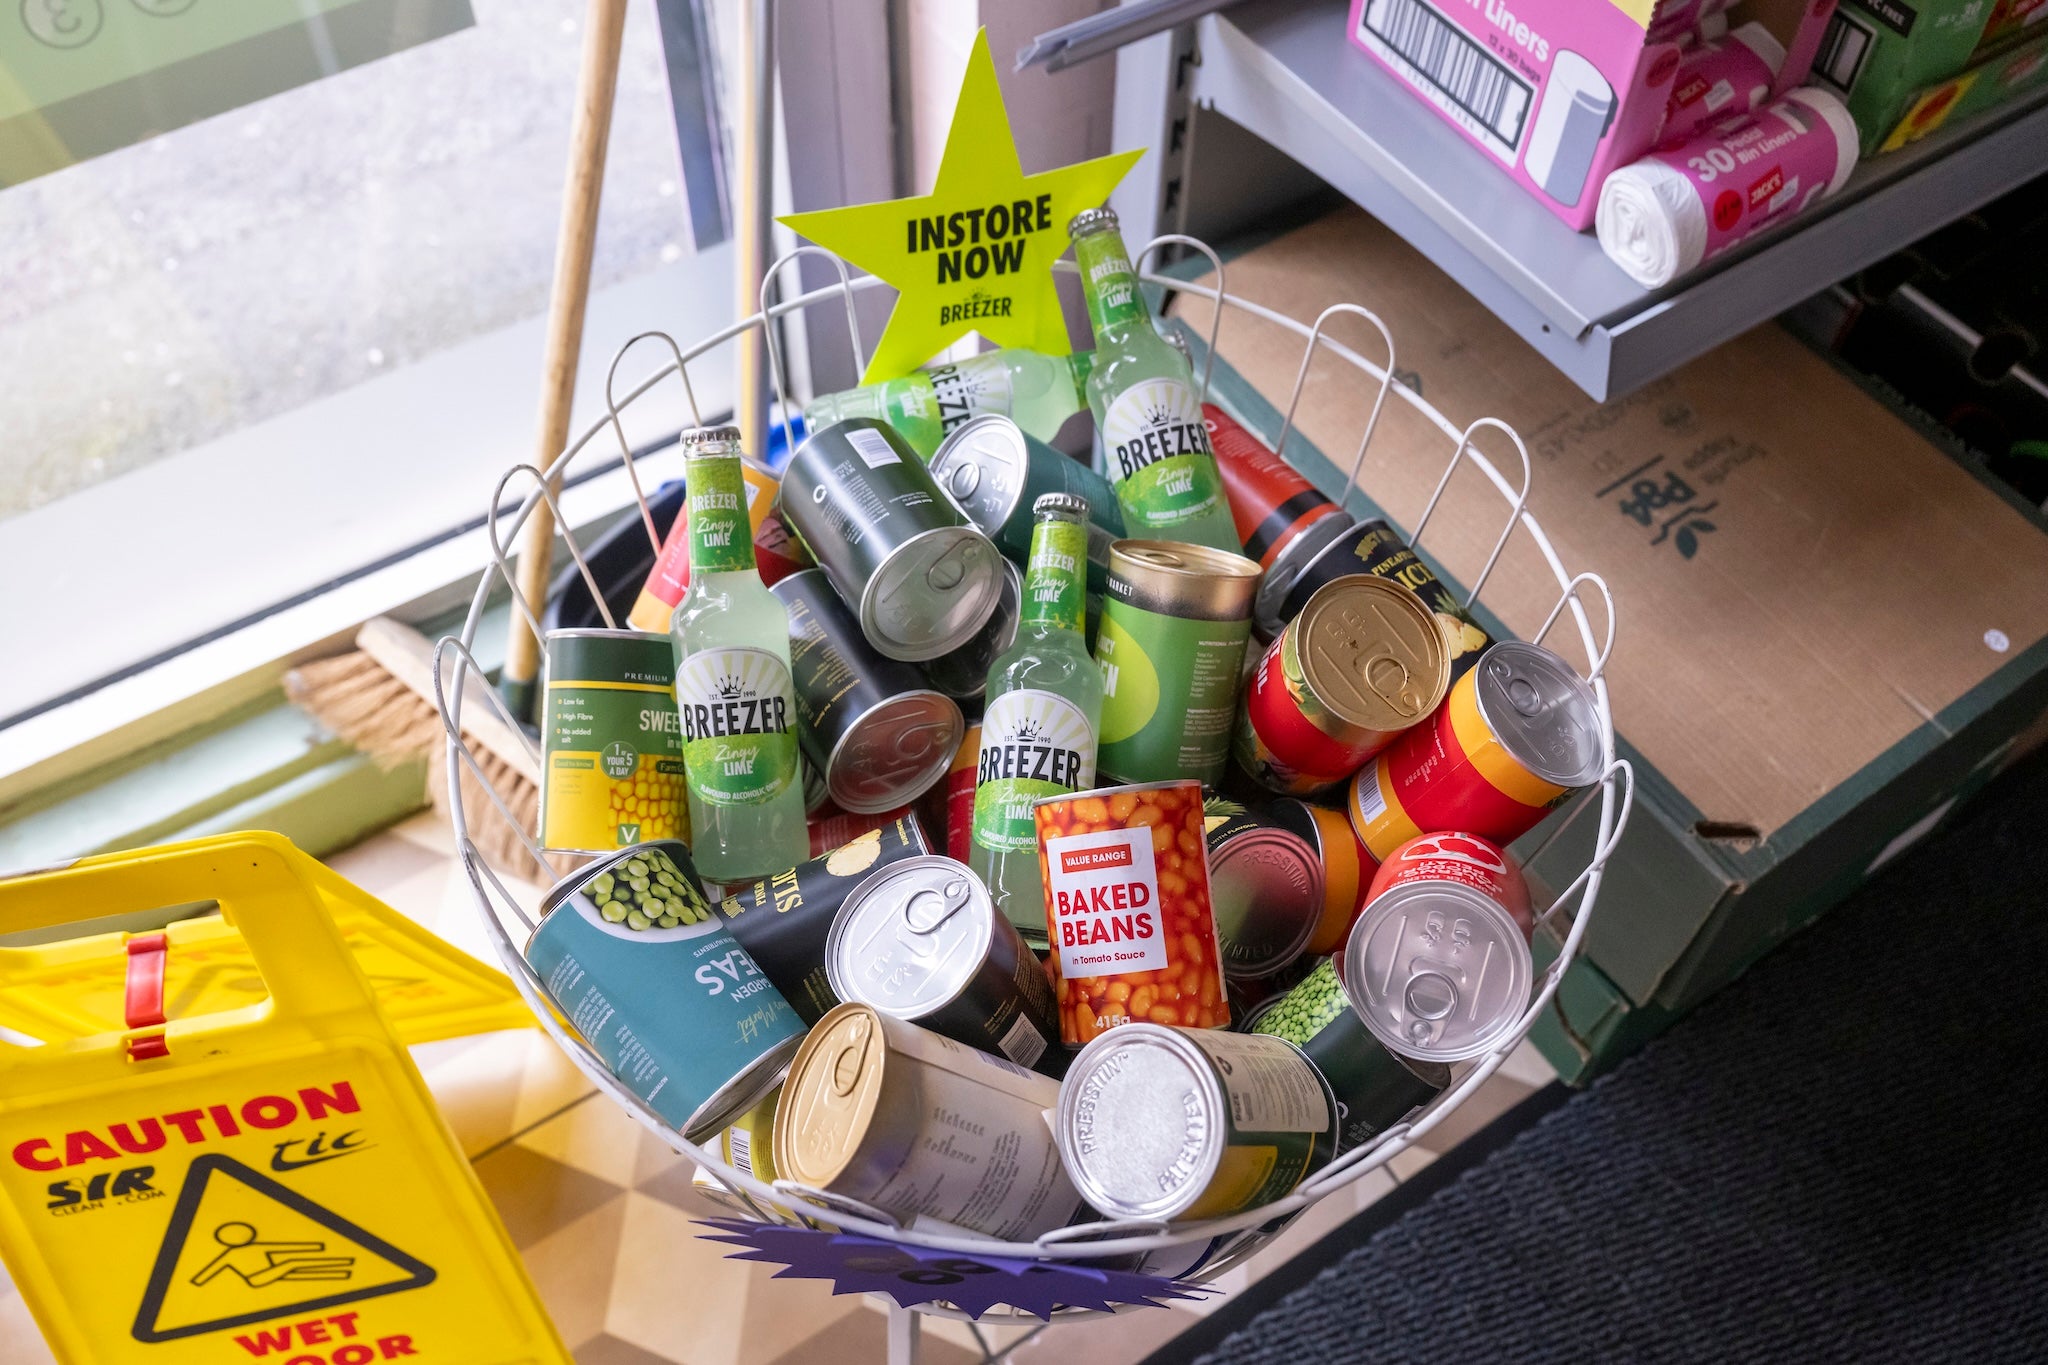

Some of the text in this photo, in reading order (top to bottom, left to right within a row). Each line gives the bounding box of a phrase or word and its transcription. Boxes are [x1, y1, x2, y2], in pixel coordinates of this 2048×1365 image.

[1484, 0, 1549, 63] Liners
[1519, 56, 1541, 82] bags
[1735, 130, 1797, 165] Bin Liners
[1688, 147, 1736, 182] 30
[1750, 174, 1782, 204] JACK'S
[908, 194, 1052, 253] INSTORE
[938, 238, 1026, 284] NOW
[1107, 291, 1133, 309] LIME
[940, 297, 1012, 326] BREEZER
[1116, 423, 1211, 482] BREEZER
[1165, 479, 1193, 497] LIME
[692, 493, 738, 514] BREEZER
[696, 517, 736, 536] Zingy
[703, 532, 731, 547] LIME
[1030, 553, 1075, 573] BREEZER
[1029, 574, 1070, 594] Zingy
[1034, 588, 1060, 603] LIME
[624, 672, 668, 682] PREMIUM
[743, 690, 756, 698] 1990
[562, 713, 594, 722] High Fibre
[639, 709, 680, 732] SWEE
[683, 696, 788, 743] BREEZER
[571, 728, 592, 736] added
[606, 753, 633, 766] YOUR 5
[614, 744, 620, 756] 1
[714, 744, 760, 762] Zingy
[610, 767, 630, 776] A DAY
[724, 760, 754, 777] LIME
[978, 745, 1081, 793] BREEZER
[700, 783, 731, 799] FLAVOURED
[732, 787, 765, 800] ALCOHOLIC
[1005, 804, 1035, 820] LIME
[1007, 836, 1038, 845] ALCOHOLI
[1211, 823, 1258, 845] WITH FLAVOUR
[1065, 850, 1126, 867] VALUE RANGE
[1057, 882, 1150, 916] BAKED
[1062, 912, 1154, 947] BEANS
[693, 940, 724, 958] NUTRIENTS
[1072, 950, 1145, 965] in Tomato Sauce
[730, 977, 772, 1003] GARDEN
[734, 1002, 778, 1044] Market
[12, 1081, 362, 1172] CAUTION
[1156, 1088, 1204, 1193] PATENTED
[47, 1165, 156, 1209] SIR
[51, 1202, 104, 1218] CLEAN
[233, 1311, 359, 1358] WET
